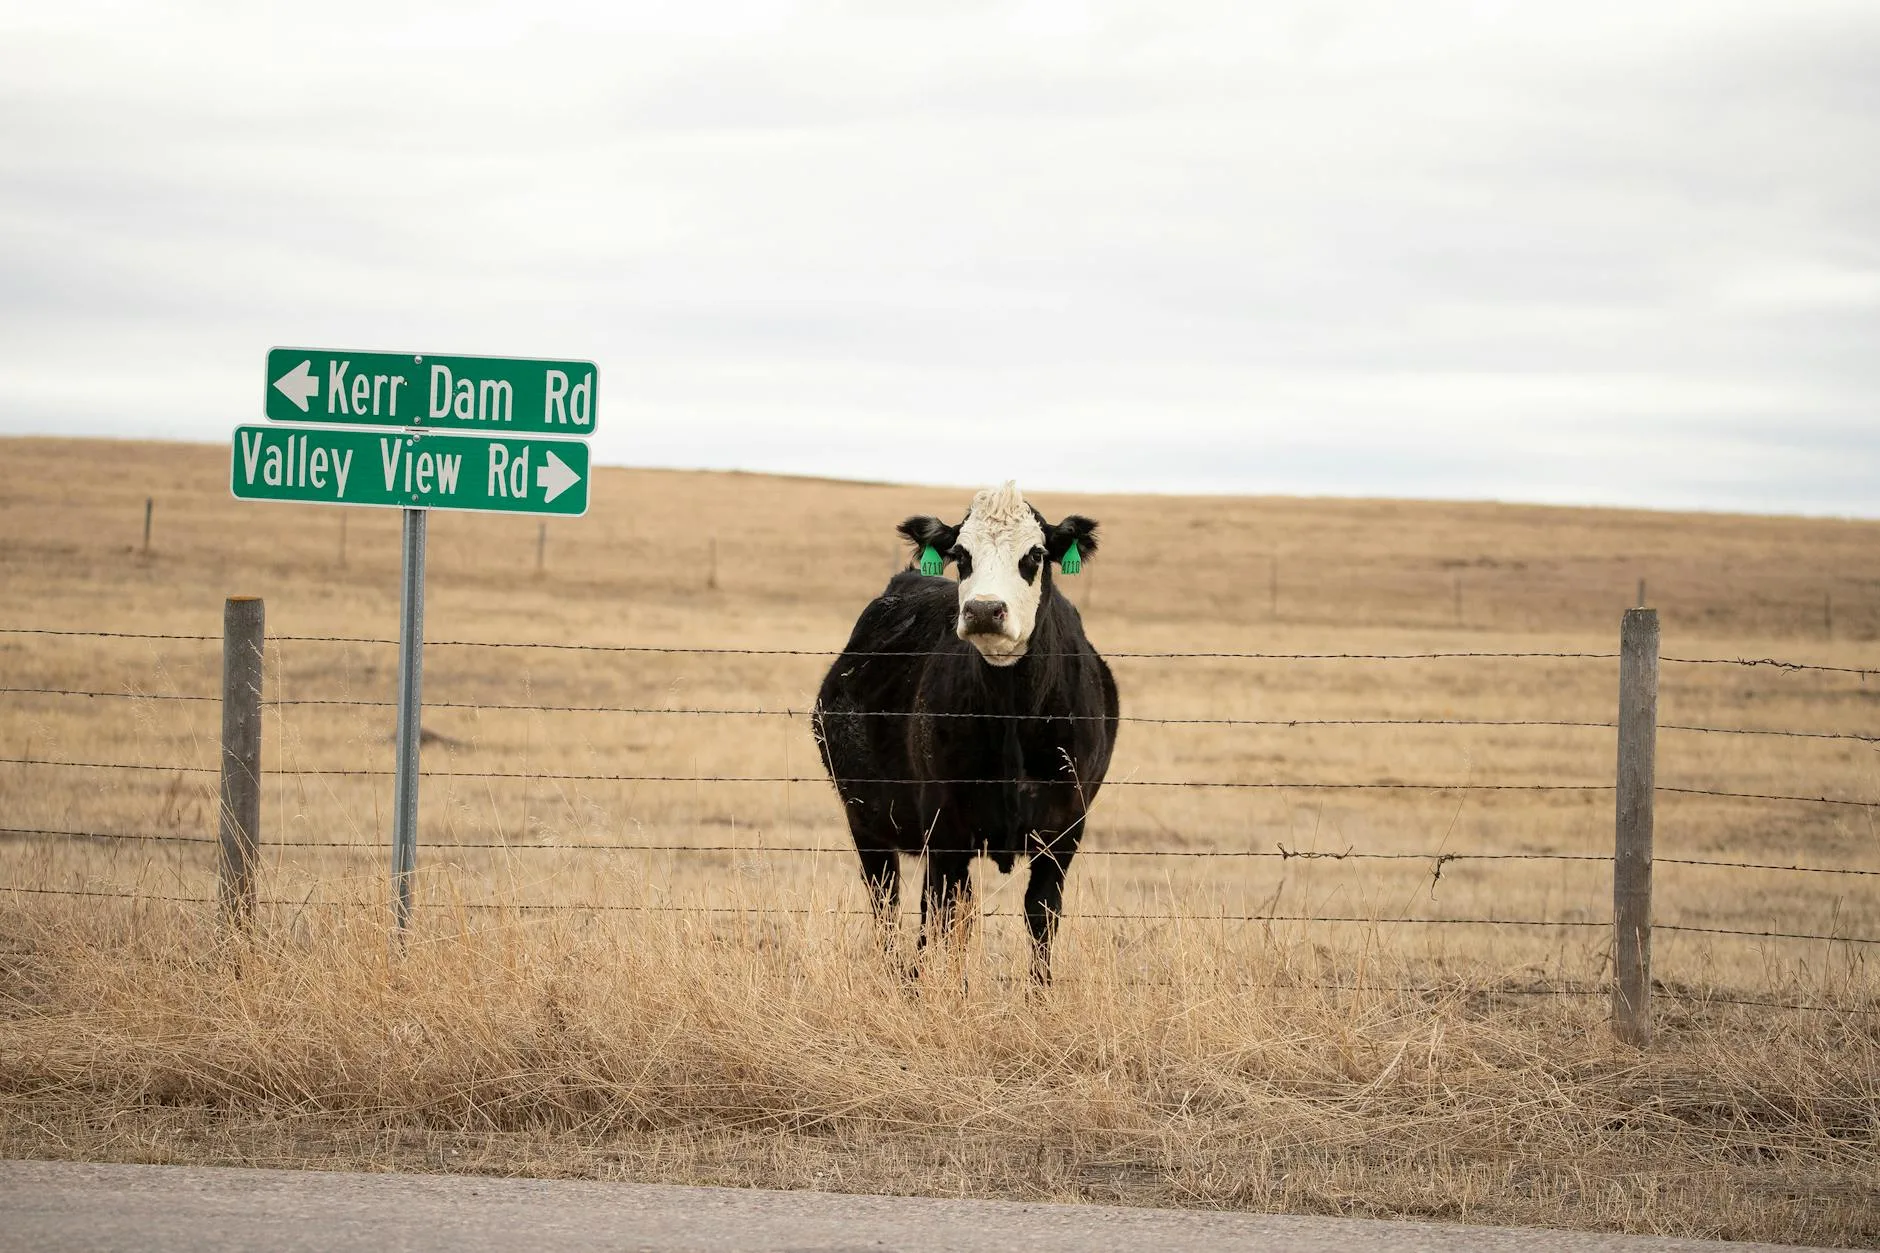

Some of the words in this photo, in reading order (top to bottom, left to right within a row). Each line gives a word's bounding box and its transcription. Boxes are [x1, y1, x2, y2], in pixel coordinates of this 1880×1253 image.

[327, 360, 405, 417] Kerr
[429, 364, 513, 422] Dam
[544, 369, 592, 425] Rd
[241, 431, 353, 498] Valley
[380, 437, 462, 495] View
[487, 443, 529, 498] Rd
[922, 561, 943, 575] 4710
[1062, 560, 1080, 575] 4710
